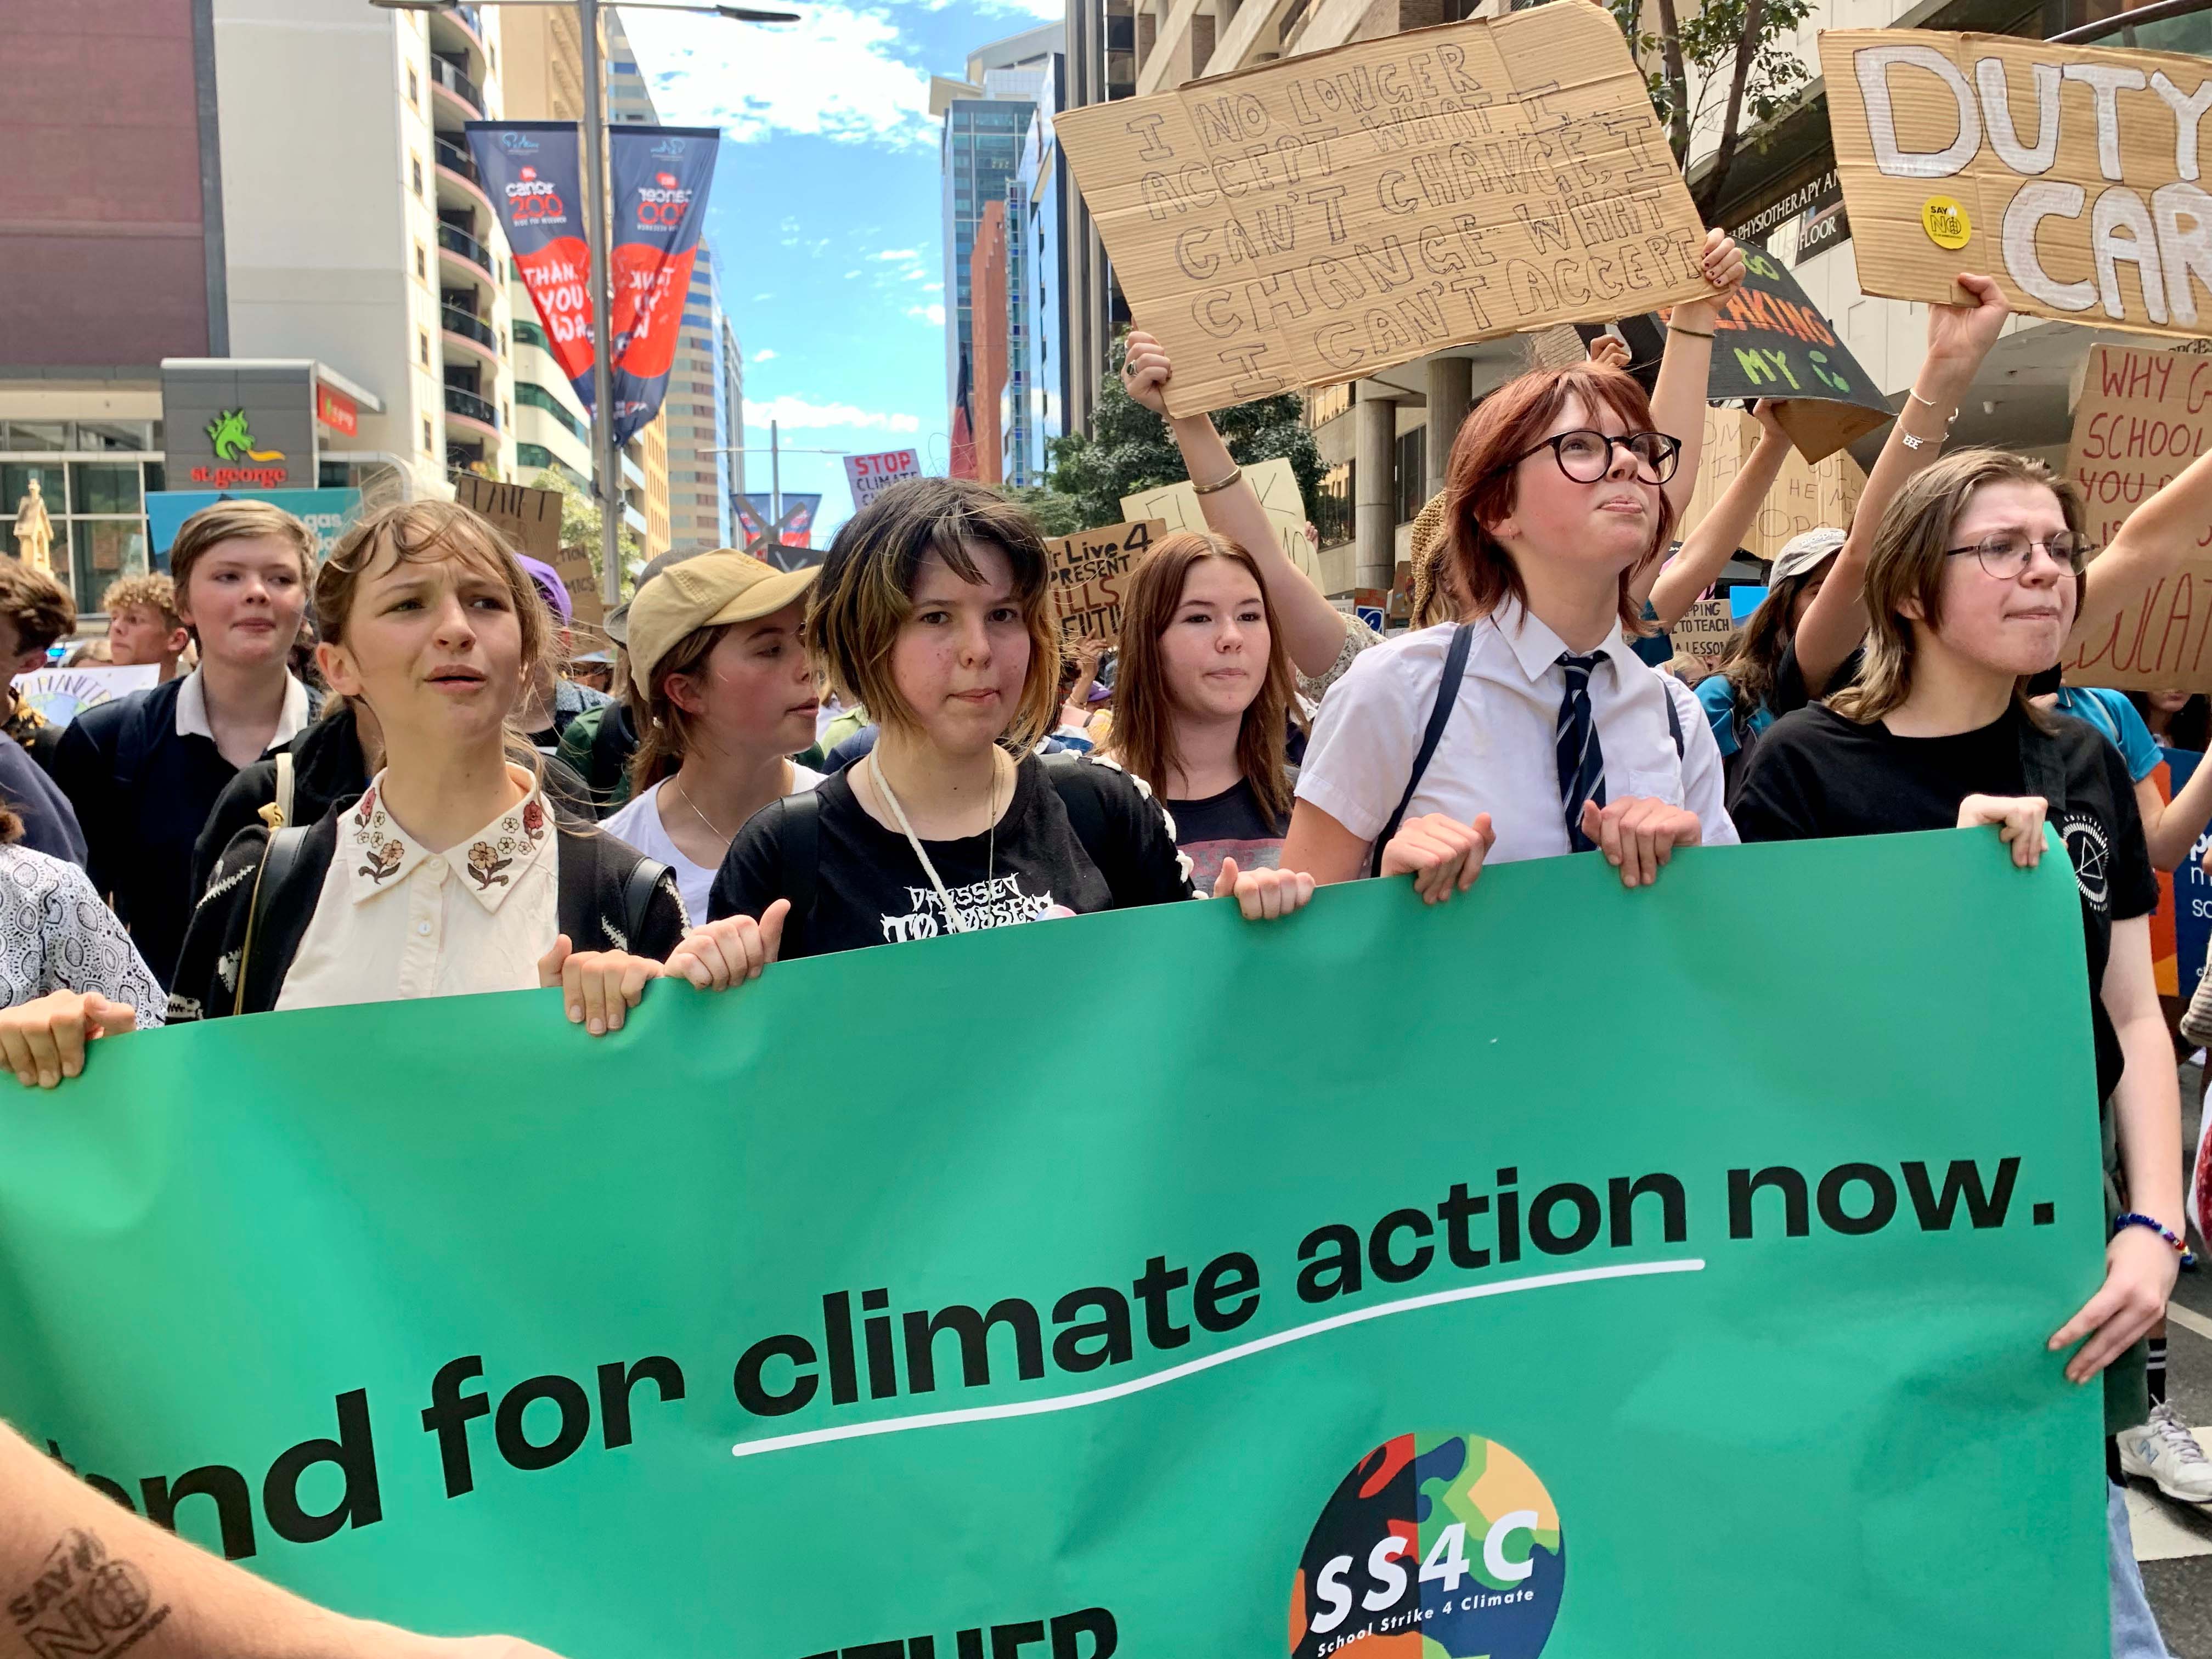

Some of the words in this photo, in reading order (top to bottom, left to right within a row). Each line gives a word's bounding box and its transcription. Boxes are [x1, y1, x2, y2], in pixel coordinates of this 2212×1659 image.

[1127, 113, 1173, 162] I
[1195, 93, 1271, 146] NO
[1289, 44, 1482, 126] LONGER
[1853, 44, 2212, 182] DUTY
[1142, 127, 1342, 221] ACCEPT
[1368, 92, 1493, 153] WHAT
[1516, 80, 1570, 136] I
[509, 194, 563, 221] 200
[1176, 185, 1348, 280] CAN'T
[1609, 115, 1672, 183] I
[1931, 206, 1948, 215] SAY
[1799, 216, 1837, 251] FLOOR
[523, 261, 579, 287] THAN
[1193, 214, 1499, 339] CHANGE
[1515, 186, 1663, 255] WHAT
[537, 285, 584, 315] YOU
[1218, 342, 1286, 398] I
[1316, 275, 1493, 369] CAN'T
[1506, 227, 1702, 317] ACCEPT
[1713, 286, 1836, 348] AKING
[2102, 349, 2175, 403] WHY
[2082, 412, 2203, 460] SCHOOL
[190, 466, 287, 489] st.george
[854, 451, 911, 476] STOP
[2080, 467, 2145, 504] YOU
[1064, 540, 1119, 565] Live
[1123, 523, 1154, 554] 4
[1050, 554, 1131, 586] PRESENT
[1679, 620, 1692, 633] TO
[1694, 618, 1729, 632] TEACH
[421, 1355, 685, 1499] for
[733, 1251, 1261, 1417] climate
[1296, 1166, 1688, 1304] action
[1727, 1156, 2056, 1240] now.
[1310, 1510, 1539, 1634] SS4C
[1317, 1623, 1373, 1658] School
[1380, 1609, 1434, 1632] Strike
[1442, 1601, 1452, 1615] 4
[1461, 1590, 1534, 1611] Climate
